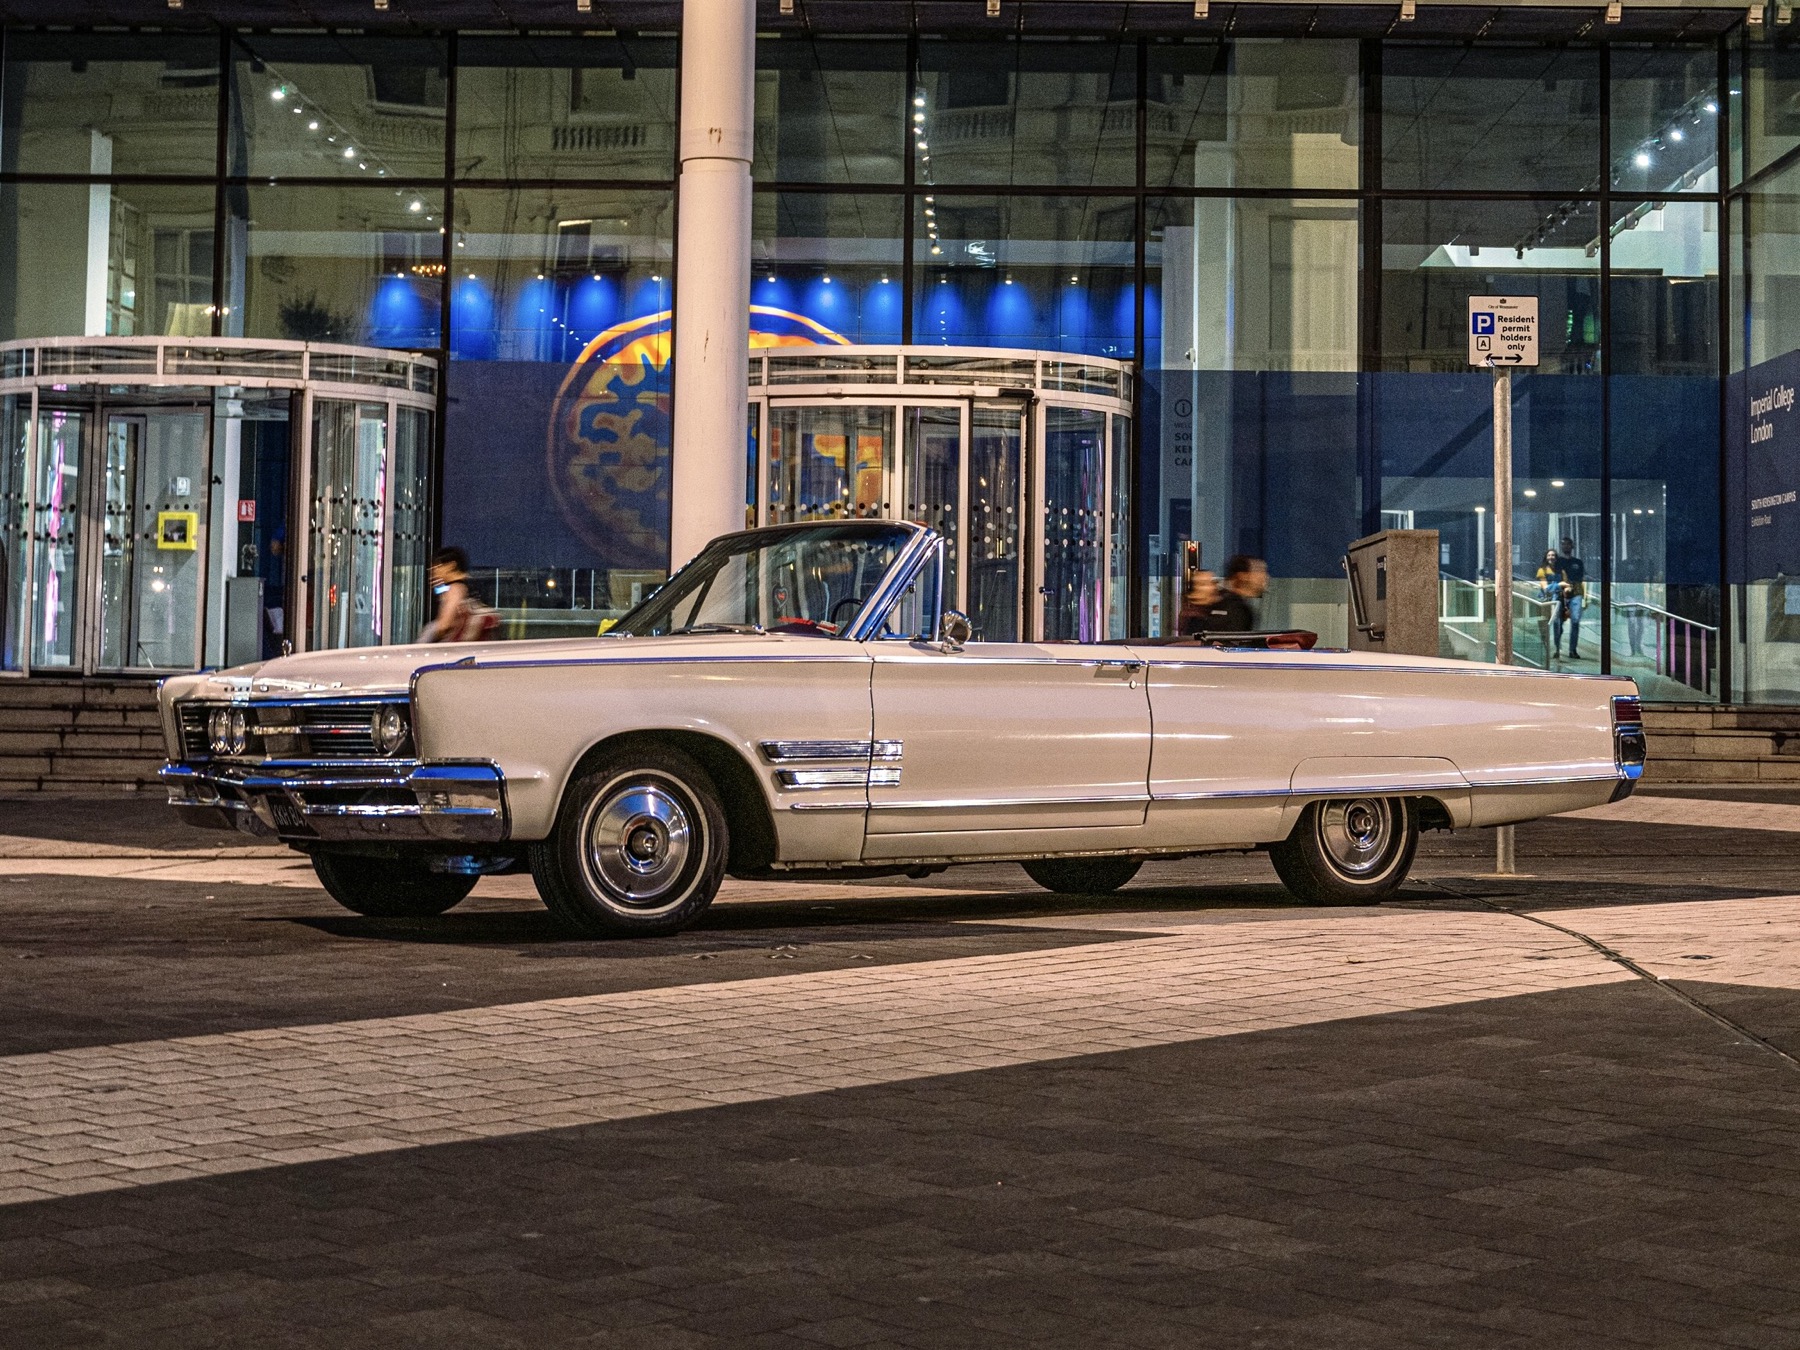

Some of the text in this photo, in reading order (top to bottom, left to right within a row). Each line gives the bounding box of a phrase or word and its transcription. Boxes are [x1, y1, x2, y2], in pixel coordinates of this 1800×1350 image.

[1478, 315, 1491, 332] P
[1508, 343, 1526, 351] only
[1750, 385, 1794, 421] Imperial College
[1750, 419, 1773, 444] London
